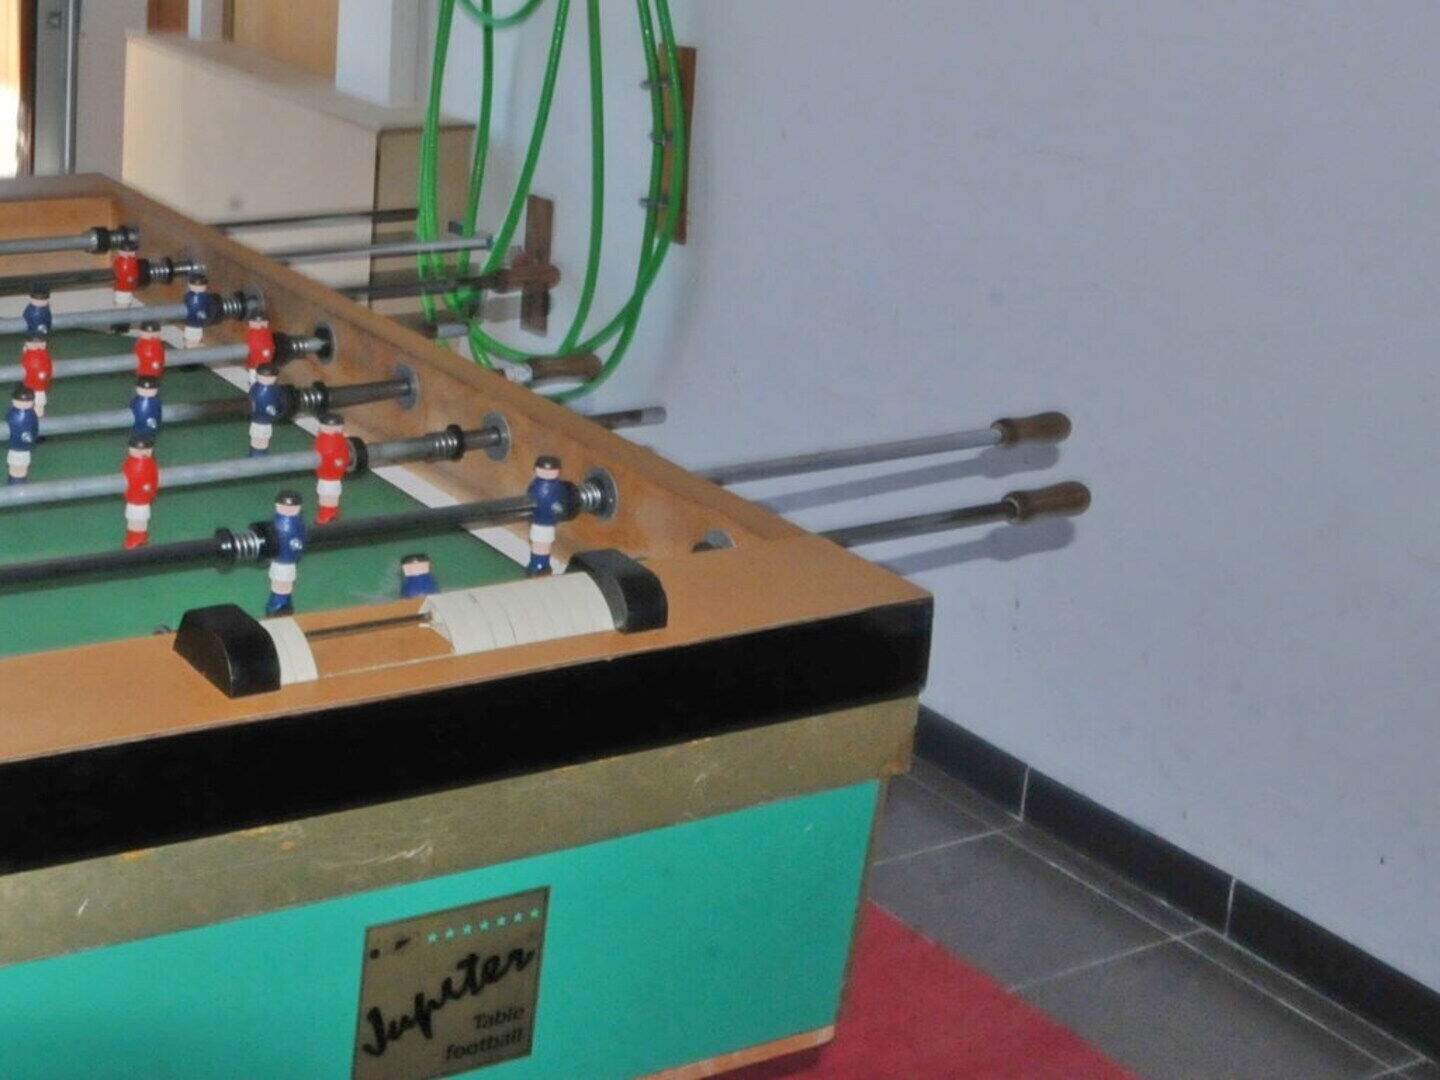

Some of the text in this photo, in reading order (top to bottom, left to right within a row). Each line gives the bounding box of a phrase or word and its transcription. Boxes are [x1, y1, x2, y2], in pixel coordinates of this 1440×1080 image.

[363, 947, 535, 1058] Jupiter
[474, 1006, 526, 1031] Table
[446, 1027, 524, 1060] football
